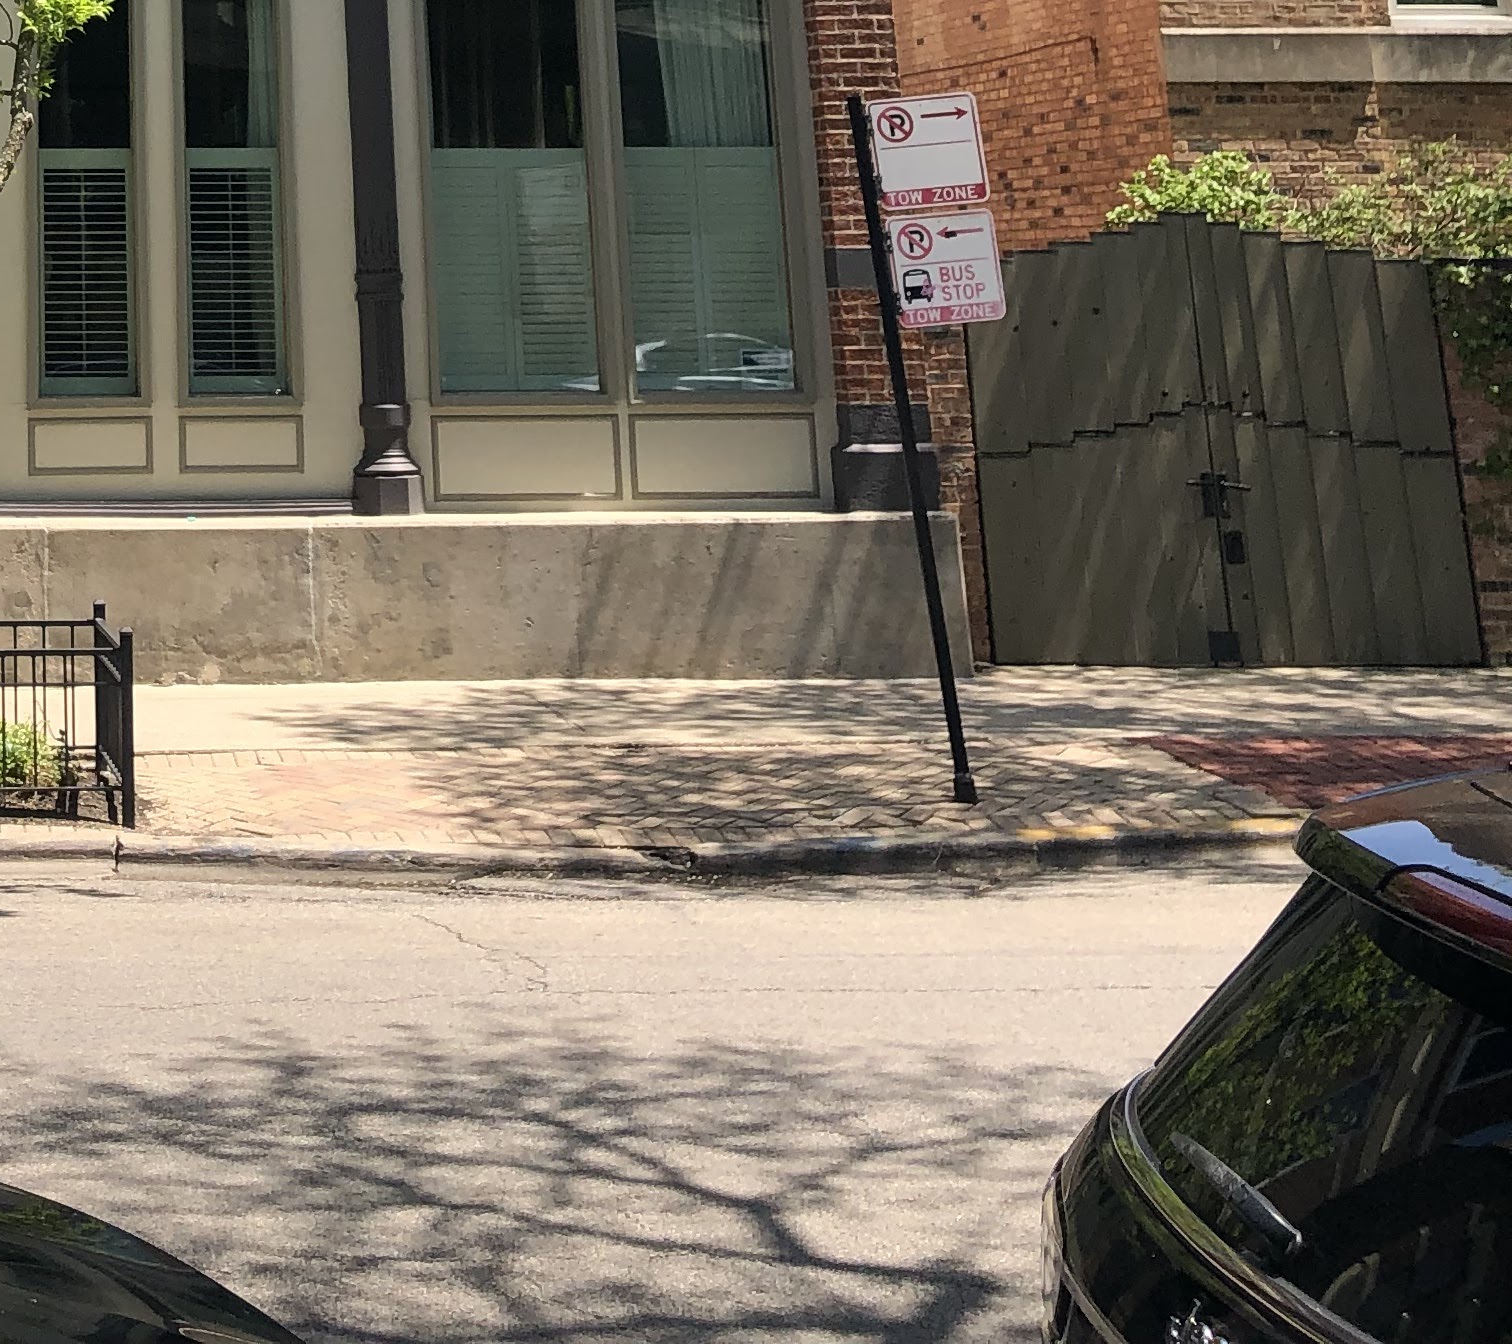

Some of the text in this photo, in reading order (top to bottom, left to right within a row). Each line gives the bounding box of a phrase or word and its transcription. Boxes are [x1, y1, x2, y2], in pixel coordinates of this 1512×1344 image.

[887, 185, 979, 206] TOW ZONE
[938, 264, 976, 283] BUS
[941, 282, 987, 302] STOP
[905, 303, 996, 324] TOW ZONE
